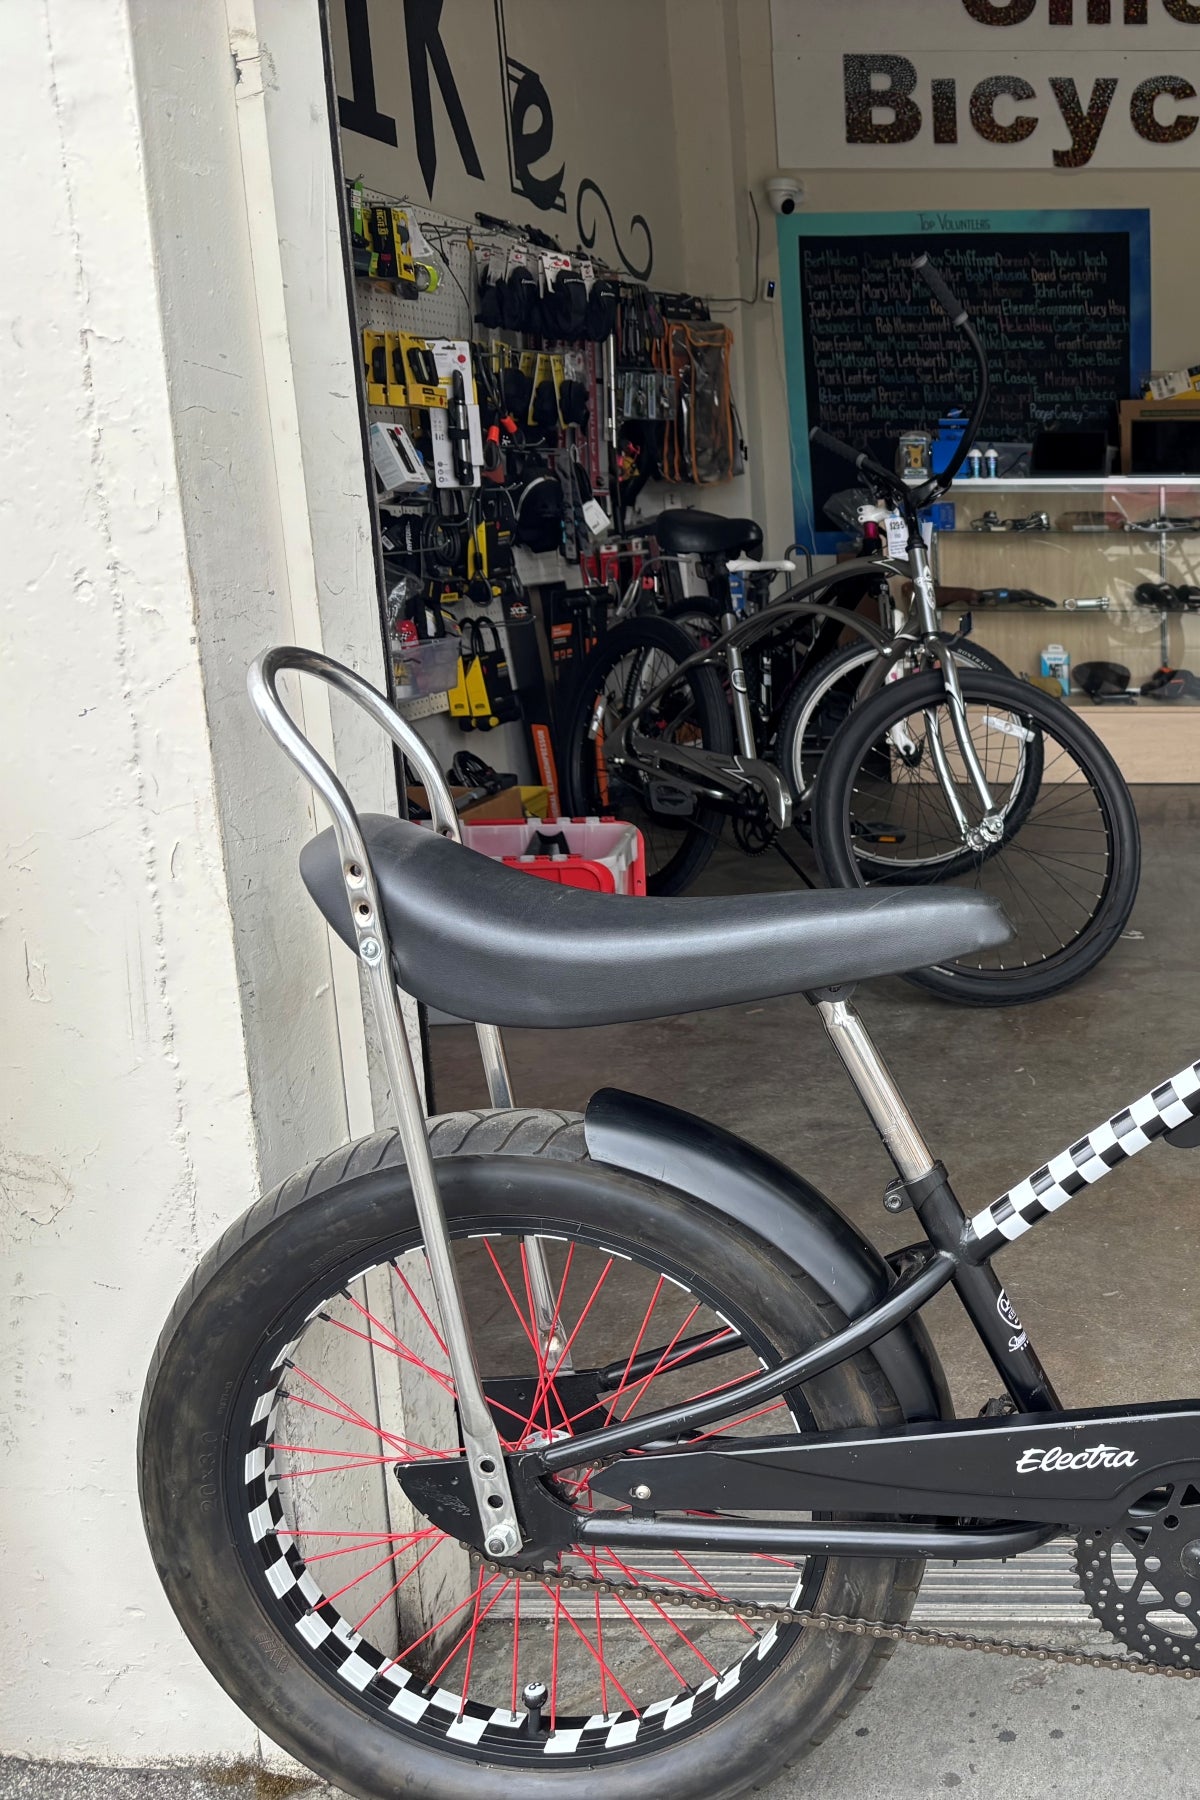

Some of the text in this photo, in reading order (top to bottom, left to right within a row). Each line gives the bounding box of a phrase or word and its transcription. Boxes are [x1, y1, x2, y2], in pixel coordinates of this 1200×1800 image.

[965, 268, 983, 282] Bob
[1031, 268, 1057, 281] David
[862, 284, 888, 303] Mary
[889, 282, 911, 303] Kelly
[1033, 283, 1057, 298] John
[1084, 300, 1107, 318] Lucy
[1108, 298, 1127, 316] Hsu
[875, 317, 893, 334] Rob
[1067, 352, 1095, 368] Steve
[1016, 1444, 1140, 1473] Electra
